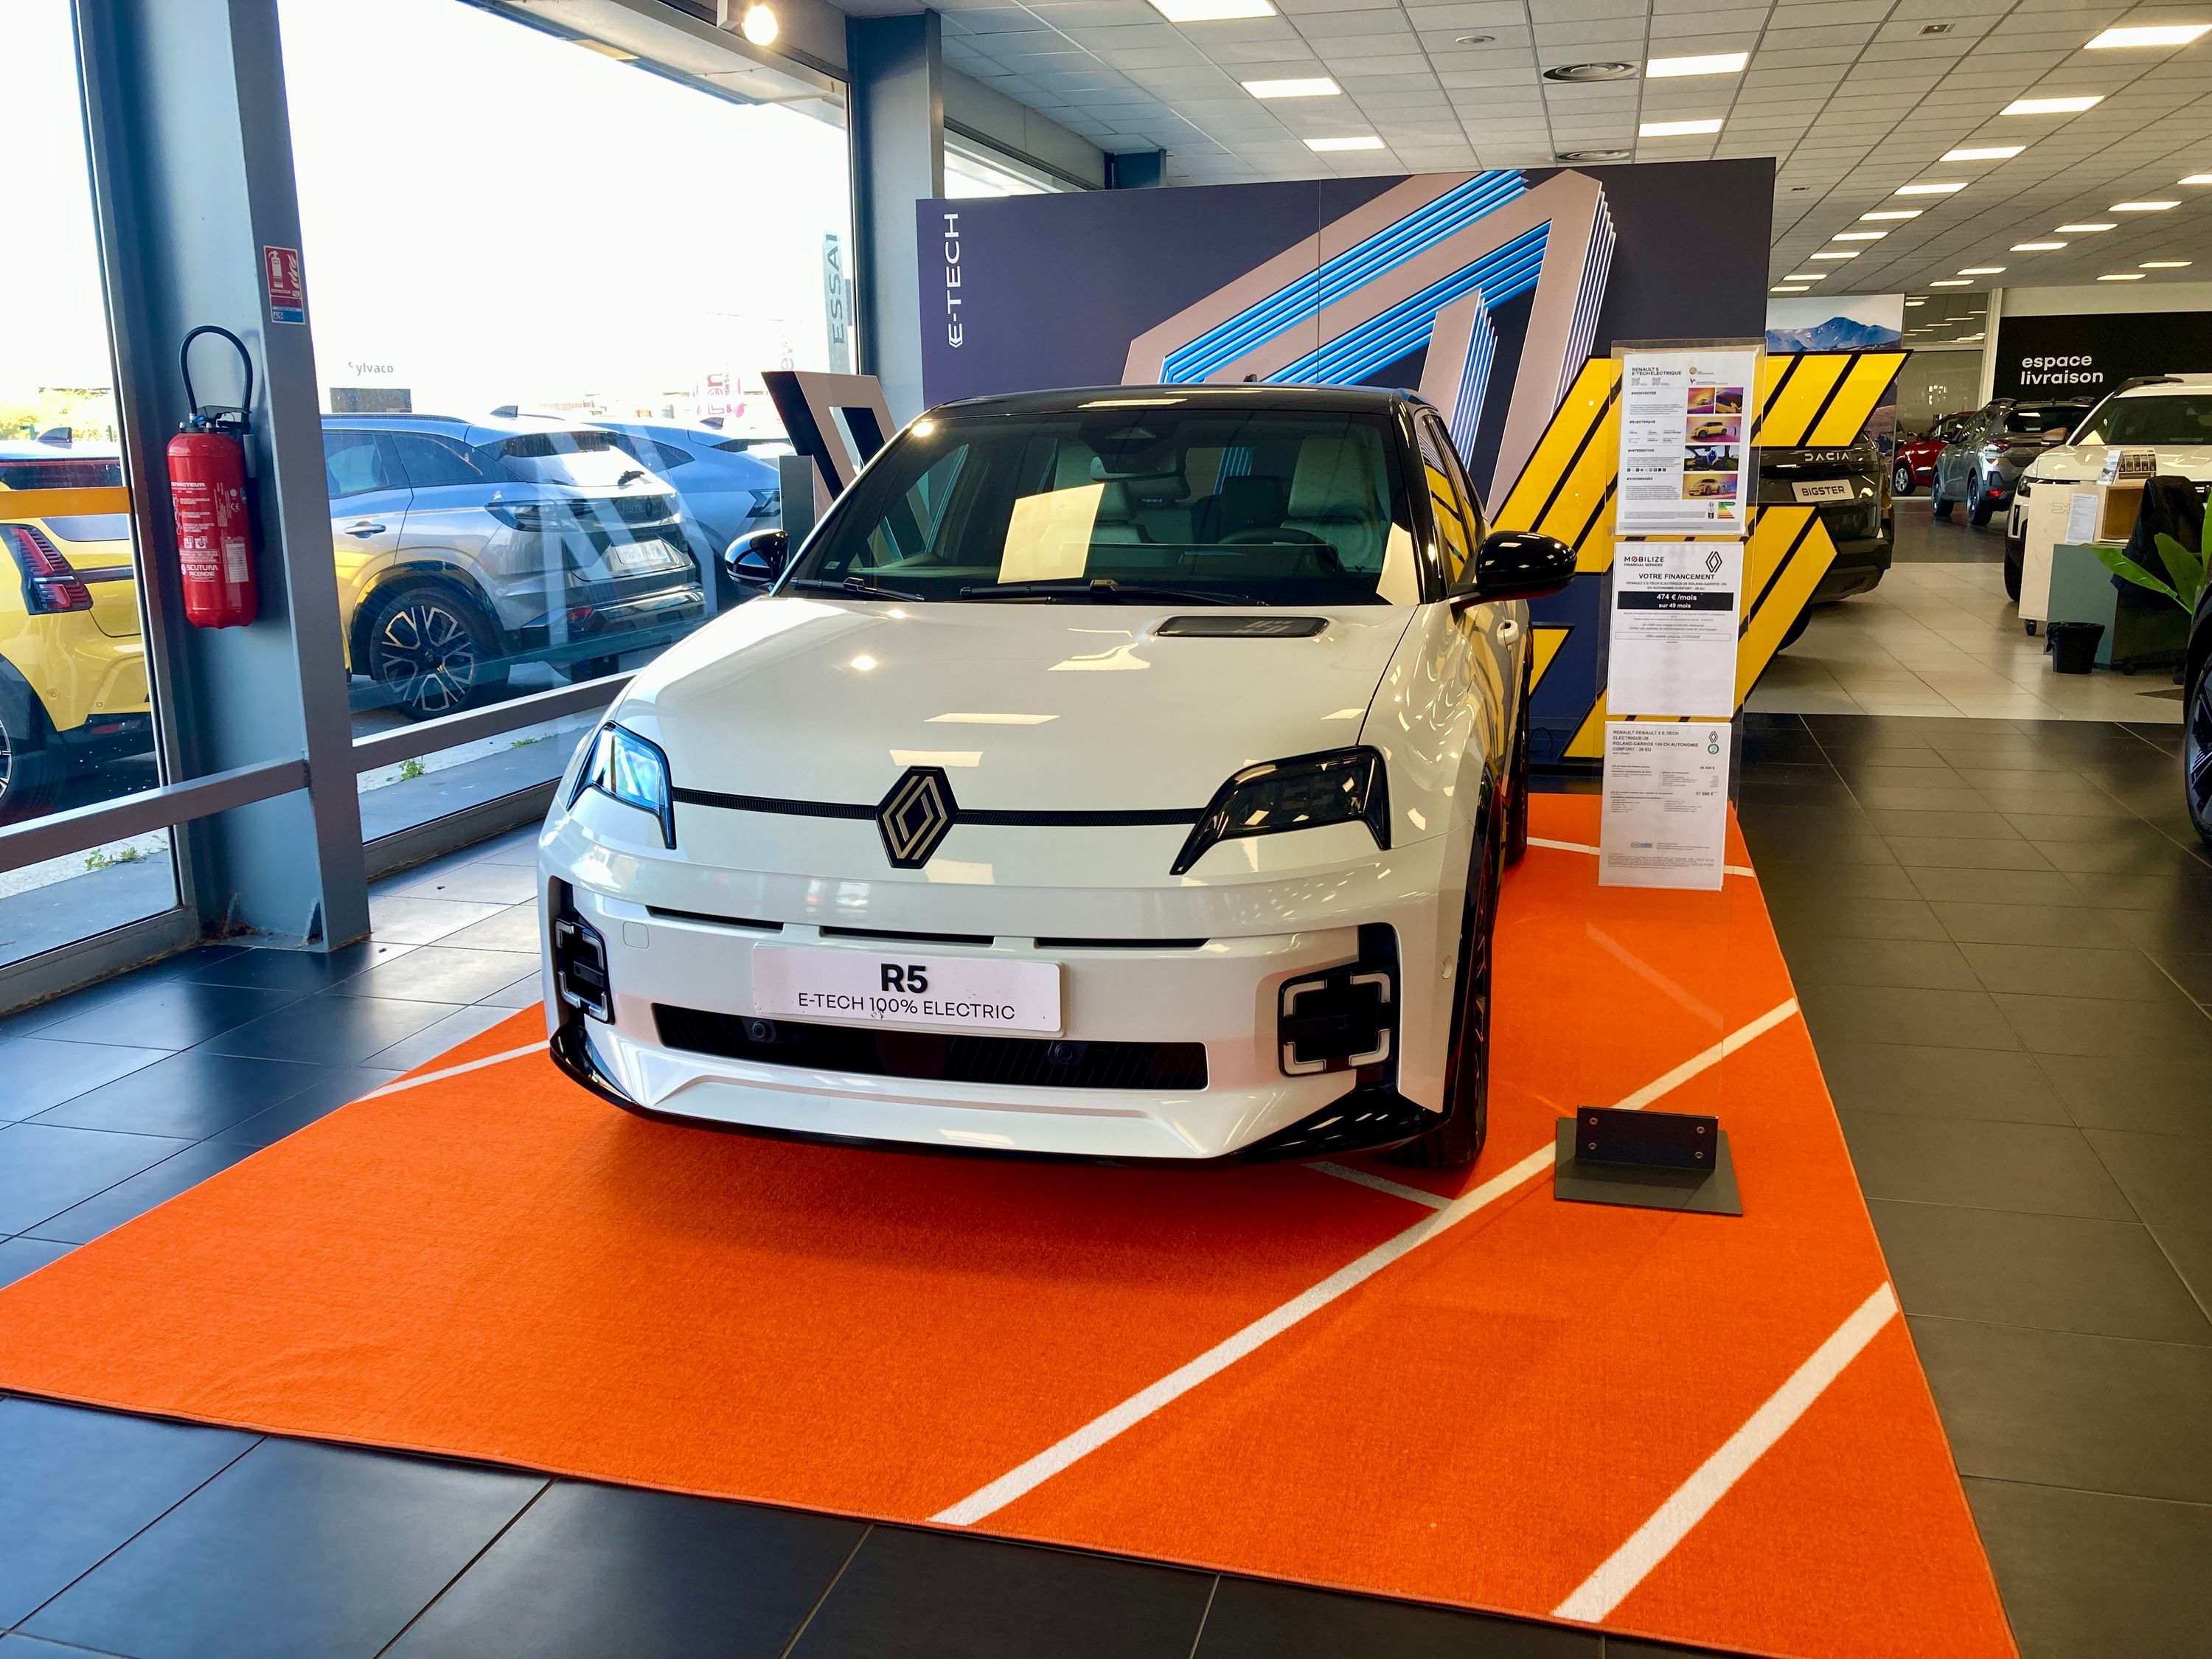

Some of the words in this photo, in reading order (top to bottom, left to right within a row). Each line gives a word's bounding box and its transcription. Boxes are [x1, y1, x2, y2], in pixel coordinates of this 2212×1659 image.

[826, 234, 844, 345] ESSAI
[944, 213, 963, 348] E-TECH
[2022, 355, 2093, 371] espace
[2020, 369, 2104, 386] livraison
[1804, 452, 1850, 461] DACIA
[1801, 485, 1846, 496] BIGSTER
[880, 963, 928, 994] R5
[799, 992, 865, 1012] E-TECH
[870, 997, 919, 1016] 100%
[923, 1001, 1016, 1020] ELECTRIC
